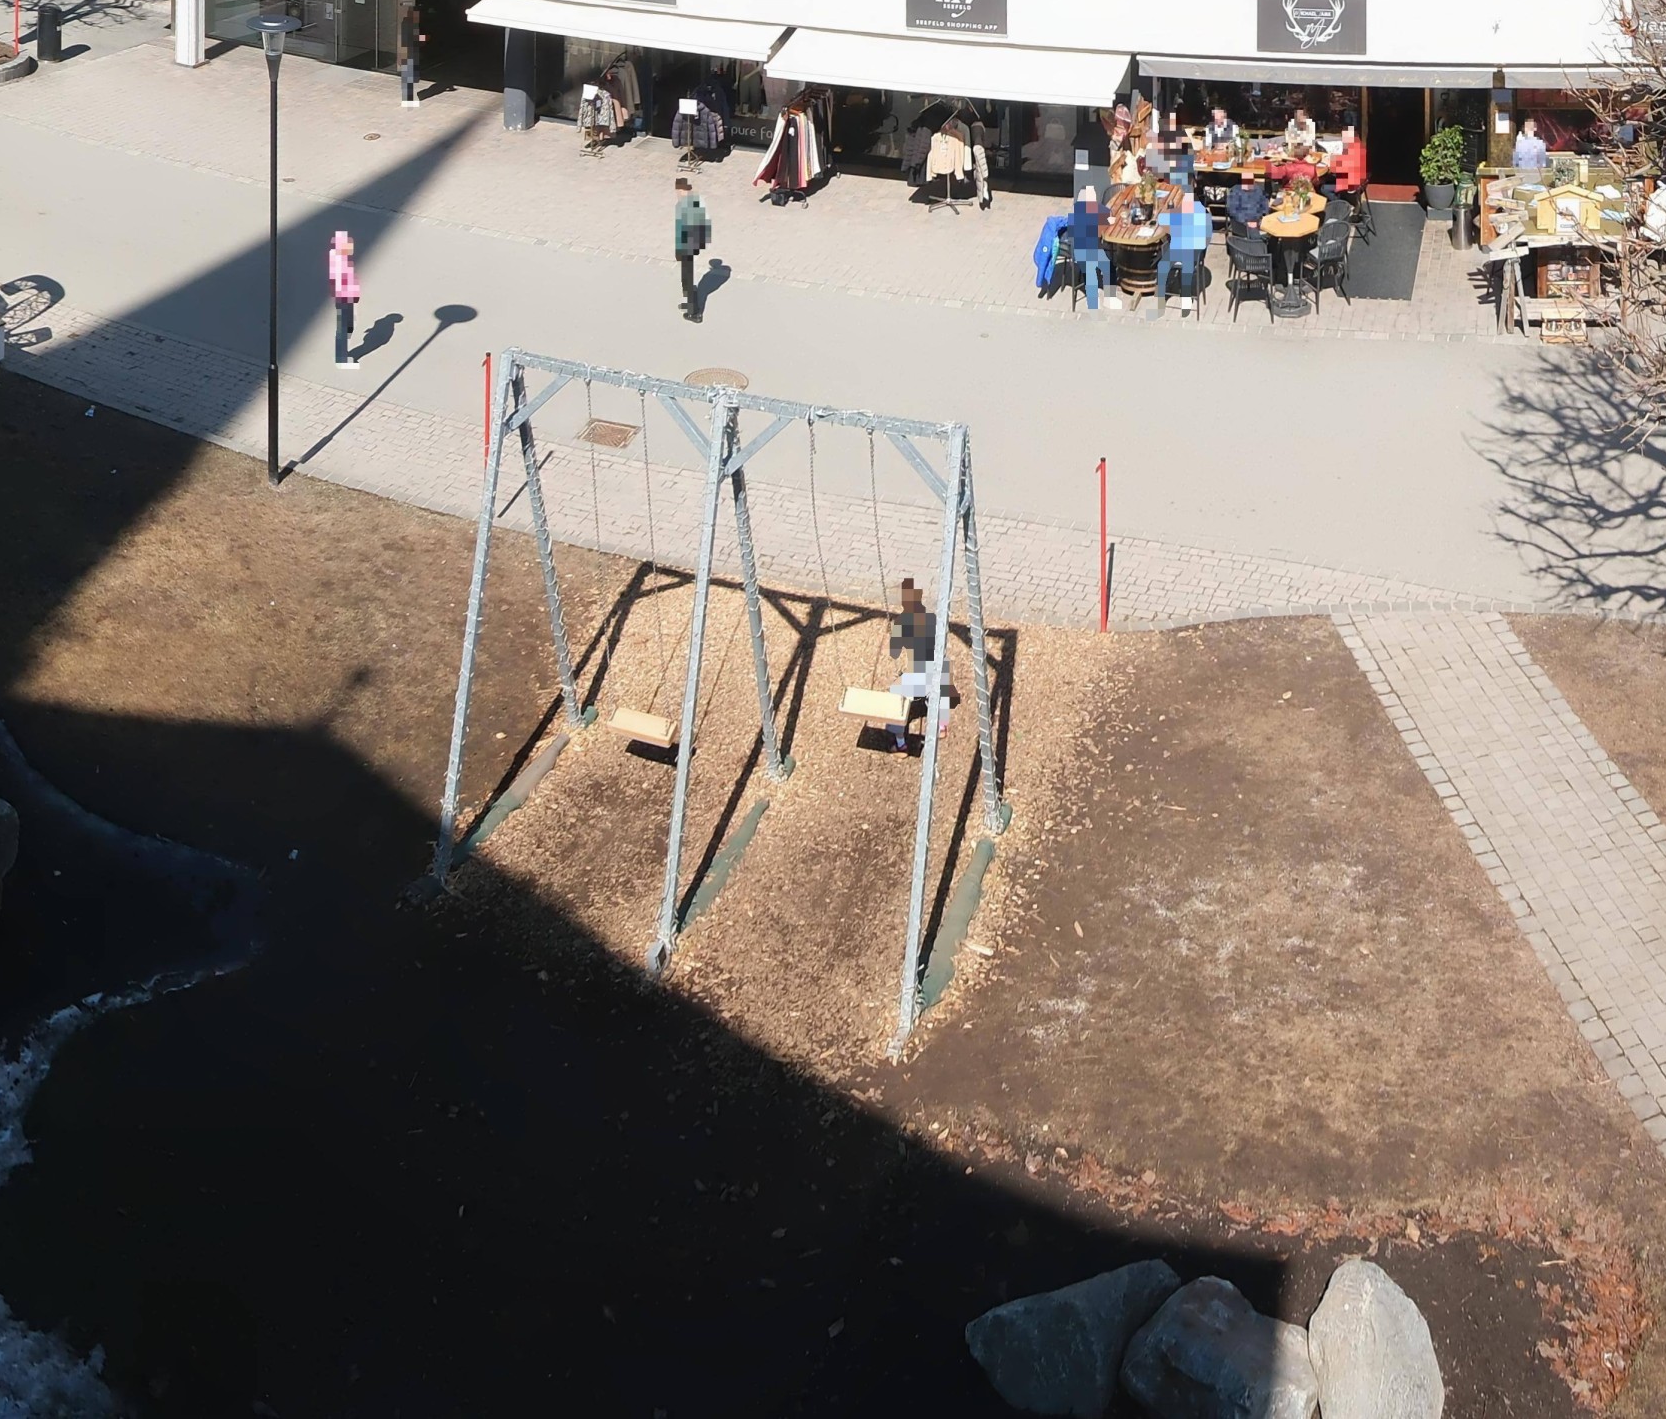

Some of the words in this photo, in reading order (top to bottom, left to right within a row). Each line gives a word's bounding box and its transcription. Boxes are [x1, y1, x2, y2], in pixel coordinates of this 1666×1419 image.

[943, 3, 972, 11] SEEFELD
[916, 19, 945, 27] SEEFELD
[947, 21, 982, 29] SHOPPING
[730, 126, 757, 138] pure
